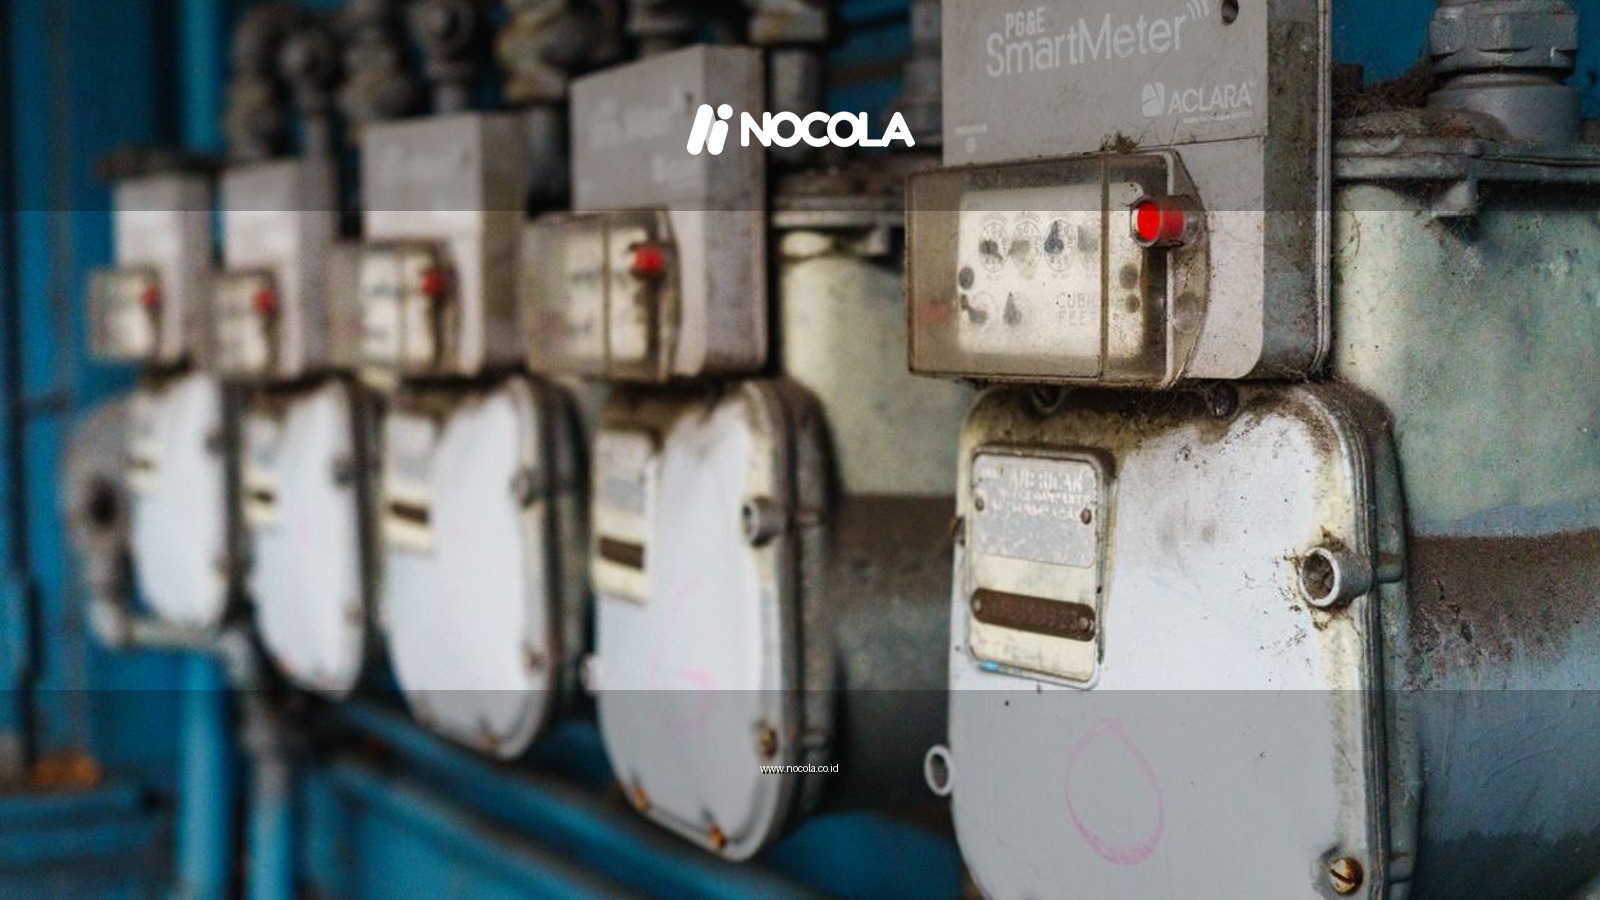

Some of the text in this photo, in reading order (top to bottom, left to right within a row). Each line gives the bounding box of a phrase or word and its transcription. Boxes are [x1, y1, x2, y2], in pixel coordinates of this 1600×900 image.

[1005, 6, 1046, 38] PG&E
[986, 13, 1186, 77] SmartMeter
[1167, 81, 1252, 115] ACLARA
